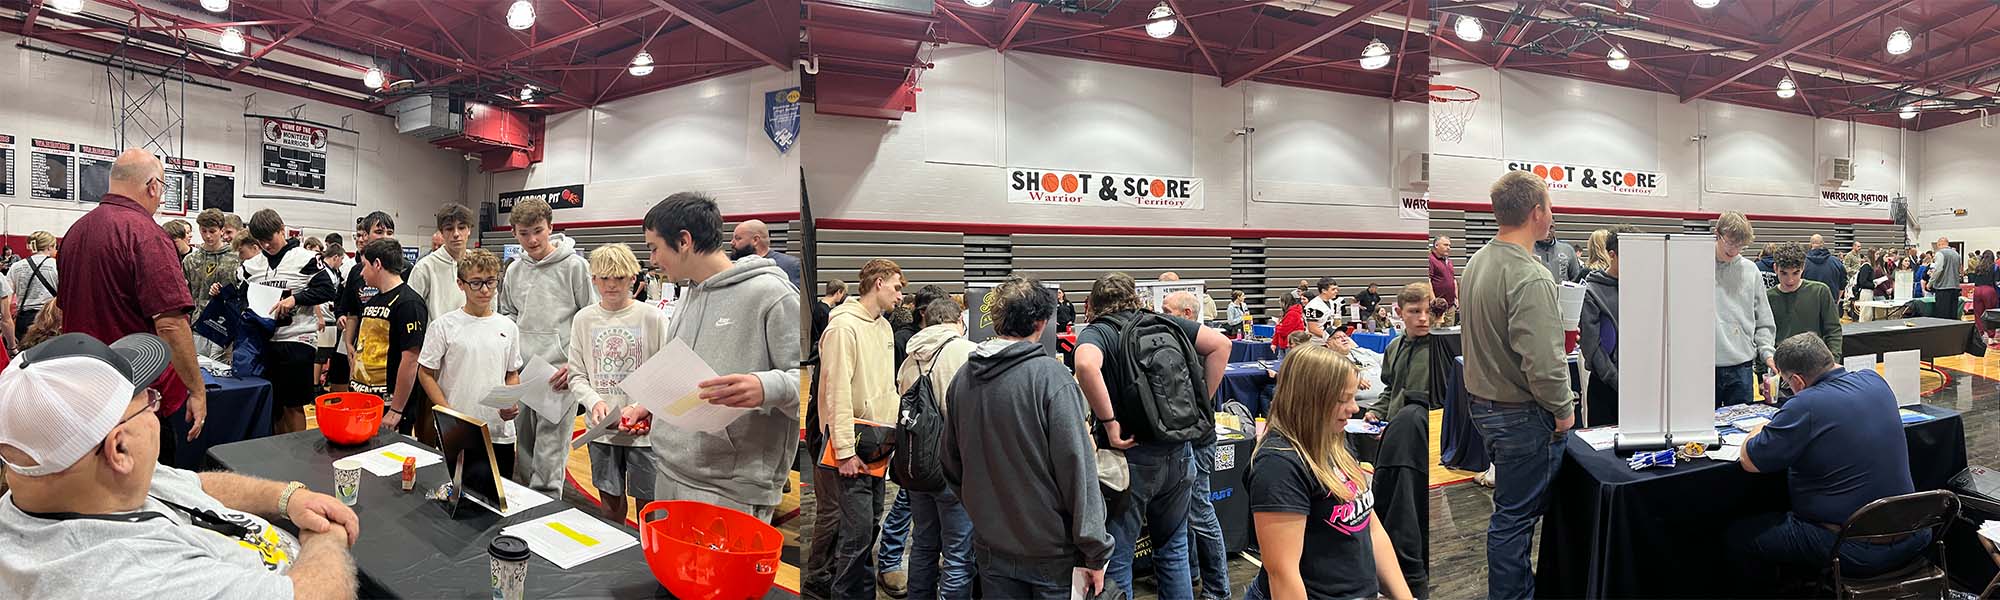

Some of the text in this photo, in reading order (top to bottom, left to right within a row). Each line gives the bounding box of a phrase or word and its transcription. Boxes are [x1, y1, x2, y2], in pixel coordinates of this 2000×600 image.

[283, 132, 310, 141] MONITEAU
[283, 138, 310, 148] WARRIORS
[1581, 168, 1598, 188] &
[1602, 170, 1657, 188] SCORE
[1011, 170, 1191, 201] SHOOT & SCORE
[1547, 181, 1569, 189] rior
[1611, 184, 1654, 194] Territory
[500, 198, 513, 208] THE
[548, 192, 561, 203] PIT
[1028, 191, 1083, 203] Warrior
[1135, 196, 1186, 208] Territory
[1821, 190, 1889, 203] WARRIOR NATION
[1402, 198, 1429, 210] WAR
[598, 356, 635, 373] 1892
